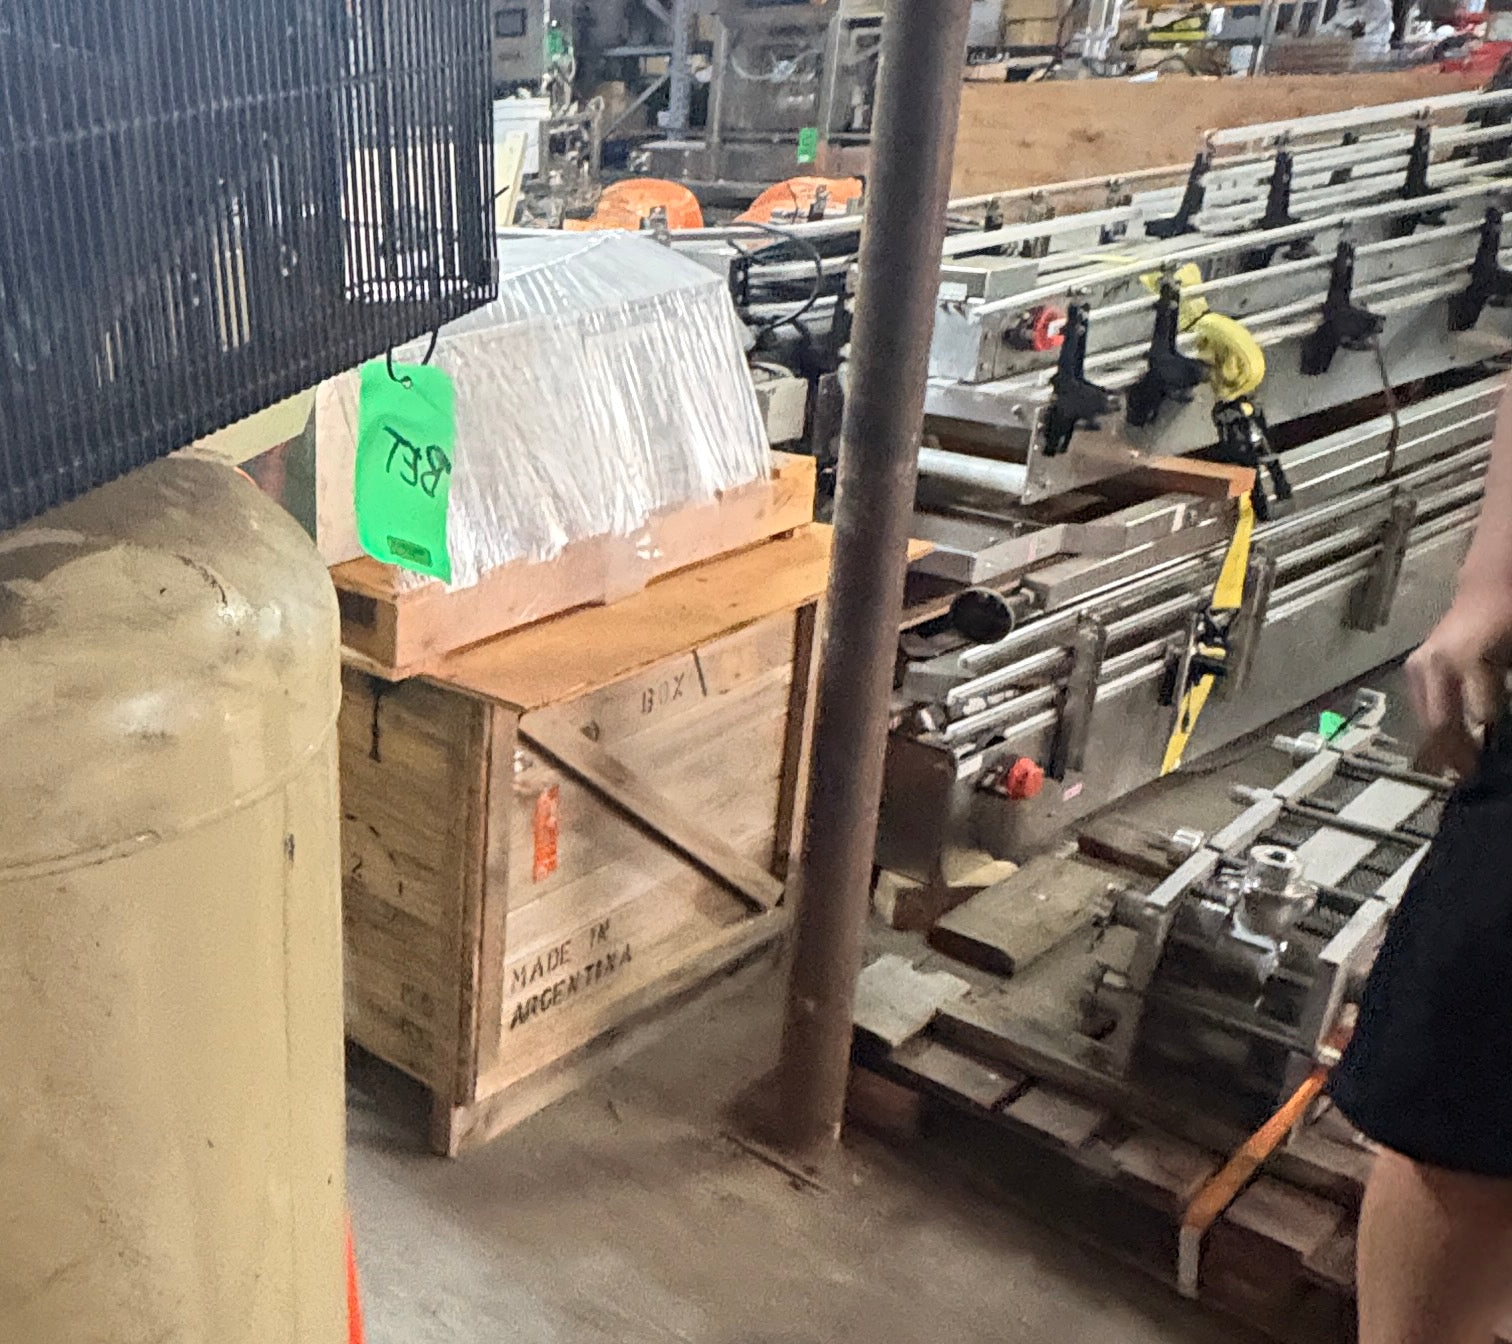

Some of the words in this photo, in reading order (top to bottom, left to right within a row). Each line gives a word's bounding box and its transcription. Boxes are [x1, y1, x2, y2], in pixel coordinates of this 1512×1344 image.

[641, 672, 685, 714] BOX
[510, 943, 632, 1030] ARGENTINA
[511, 939, 572, 994] MADE
[589, 917, 611, 949] IN
